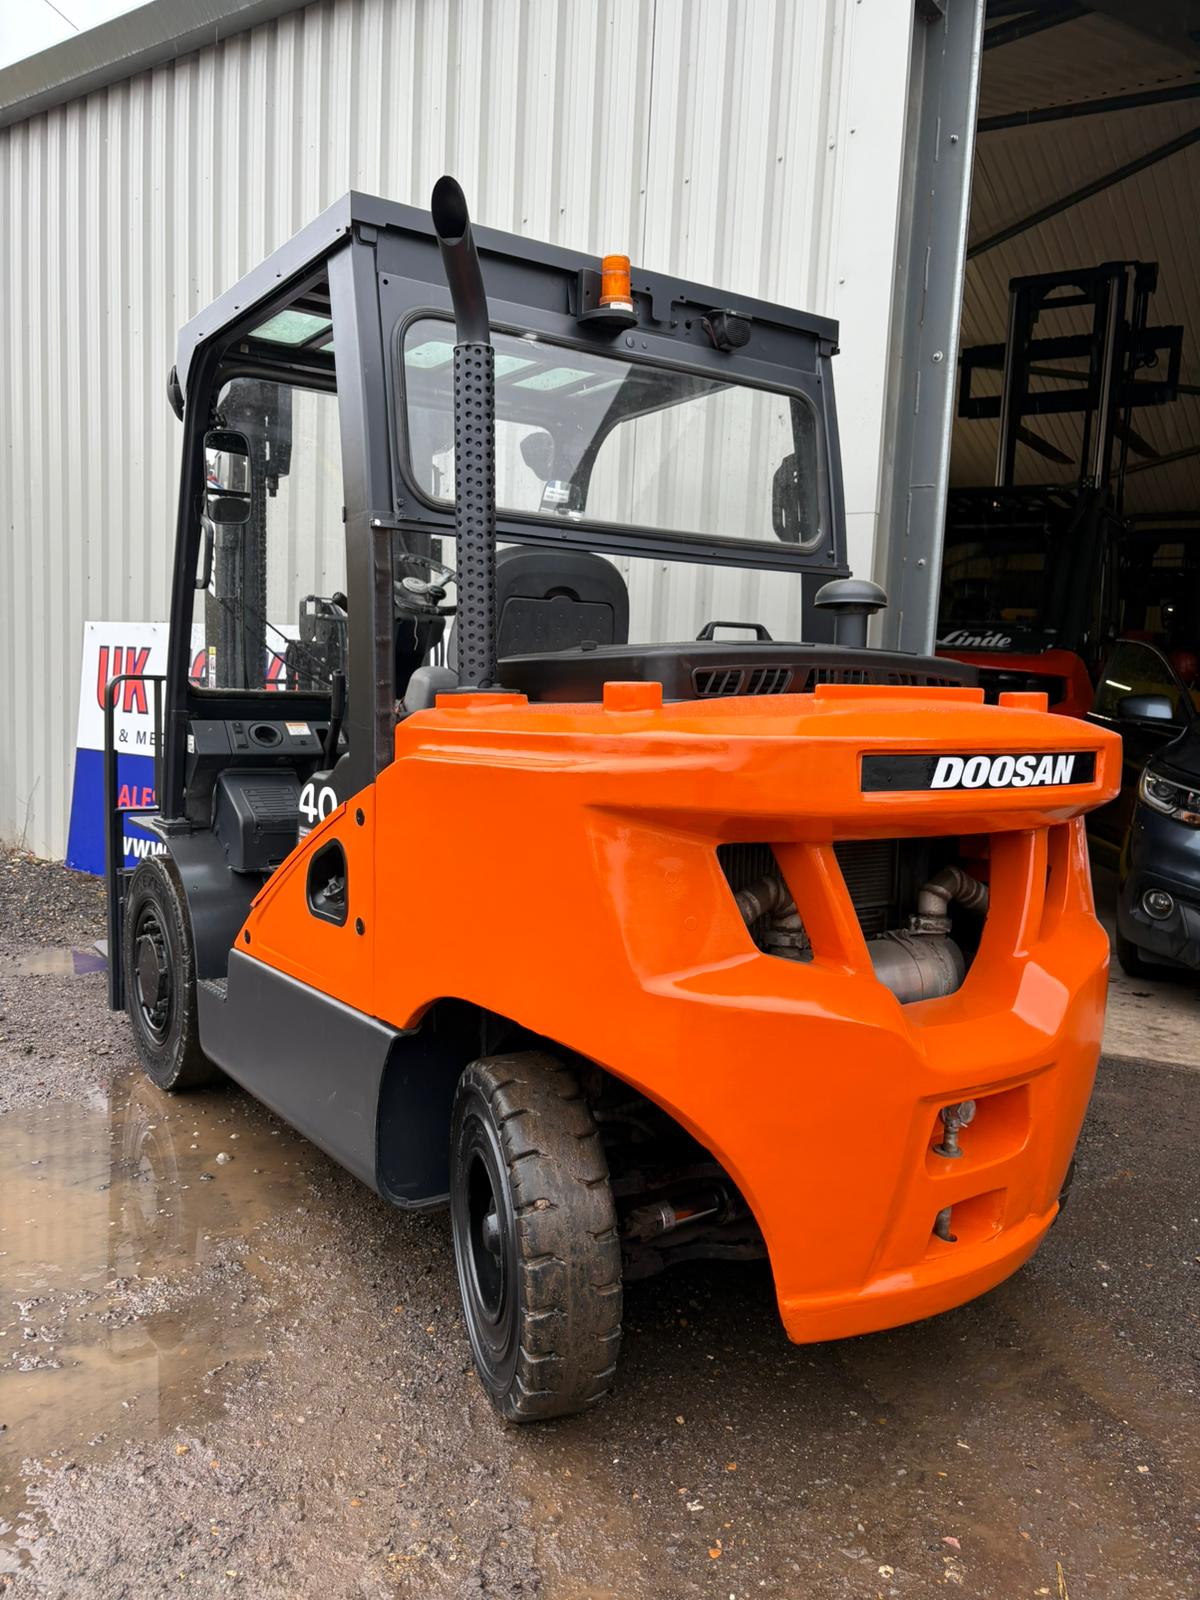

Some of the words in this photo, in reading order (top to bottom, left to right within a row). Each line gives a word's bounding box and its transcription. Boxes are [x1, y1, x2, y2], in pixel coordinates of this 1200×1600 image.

[935, 629, 1011, 647] Linde
[97, 646, 152, 714] UK
[119, 729, 128, 743] &
[136, 730, 165, 746] ME
[930, 755, 1074, 789] DOOSAN
[117, 783, 156, 808] ALE
[299, 783, 337, 823] 40
